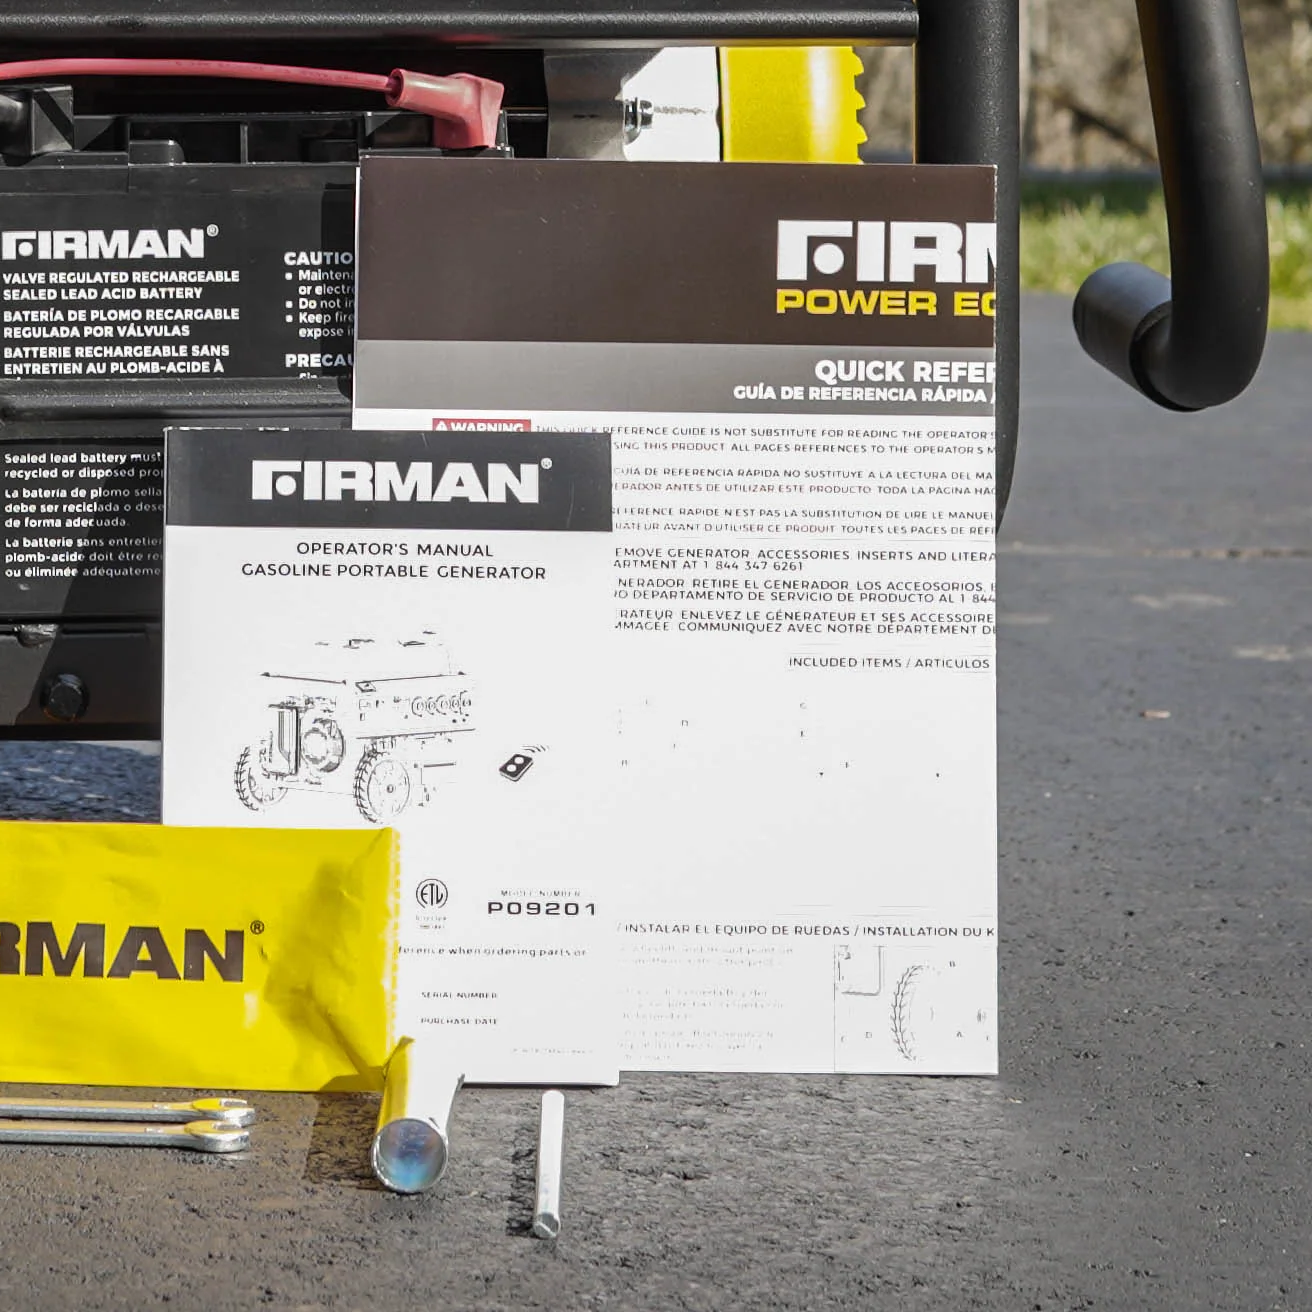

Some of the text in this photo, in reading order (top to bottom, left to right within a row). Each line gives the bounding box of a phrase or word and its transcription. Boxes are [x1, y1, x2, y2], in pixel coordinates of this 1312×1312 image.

[2, 270, 239, 284] VALVE REGULATED RECHARGEABLE
[3, 286, 202, 300] SEALED LEAD ACID BATTERY
[776, 288, 937, 315] POWER
[3, 307, 239, 322] BATERÍA DE PLOMO RECARGABLE
[3, 321, 189, 338] REGULADA POR VÁLVULAS
[3, 344, 229, 358] BATTERIE RECHARGEABLE SANS
[4, 358, 224, 375] ENTRETIEN AU PLOMB-ACIDE À
[733, 382, 987, 402] GUÍA DE REFERENCIA RÁPIDA
[4, 453, 46, 463] Sealed
[50, 452, 77, 463] lead
[80, 452, 127, 464] battery
[296, 542, 492, 557] OPERATOR'S MANUAL
[241, 563, 545, 579] GASOLINE PORTABLE GENERATOR
[488, 901, 594, 915] P09201
